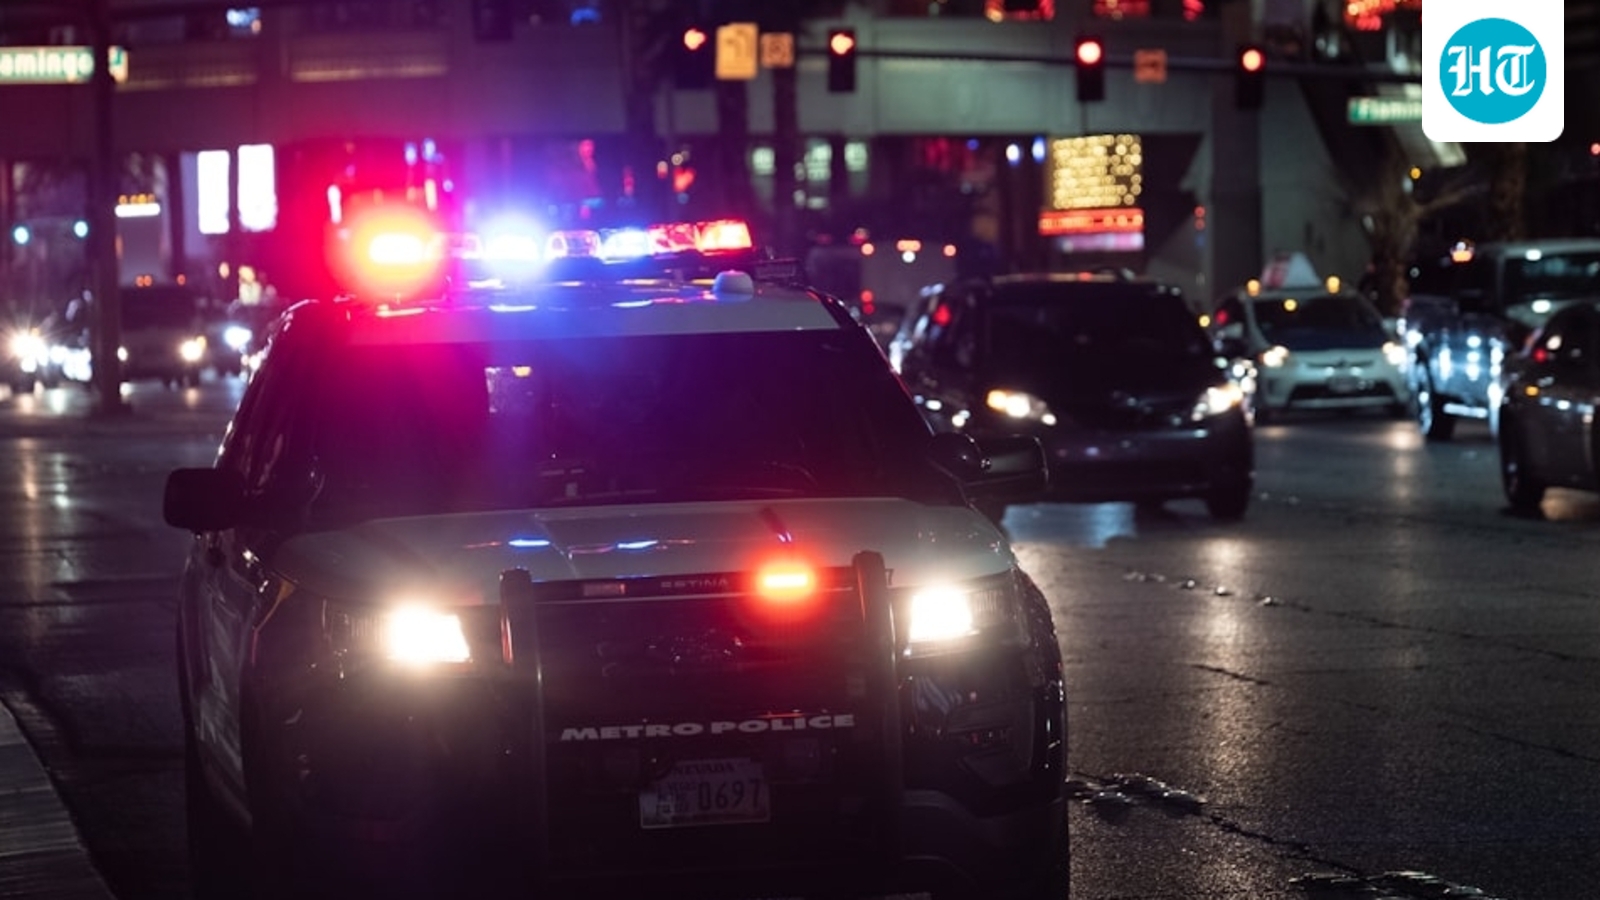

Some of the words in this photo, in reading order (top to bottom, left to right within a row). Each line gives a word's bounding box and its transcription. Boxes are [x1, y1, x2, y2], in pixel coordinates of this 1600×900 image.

[561, 722, 704, 741] METRO
[710, 714, 855, 734] POLICE
[698, 778, 760, 811] 0697
